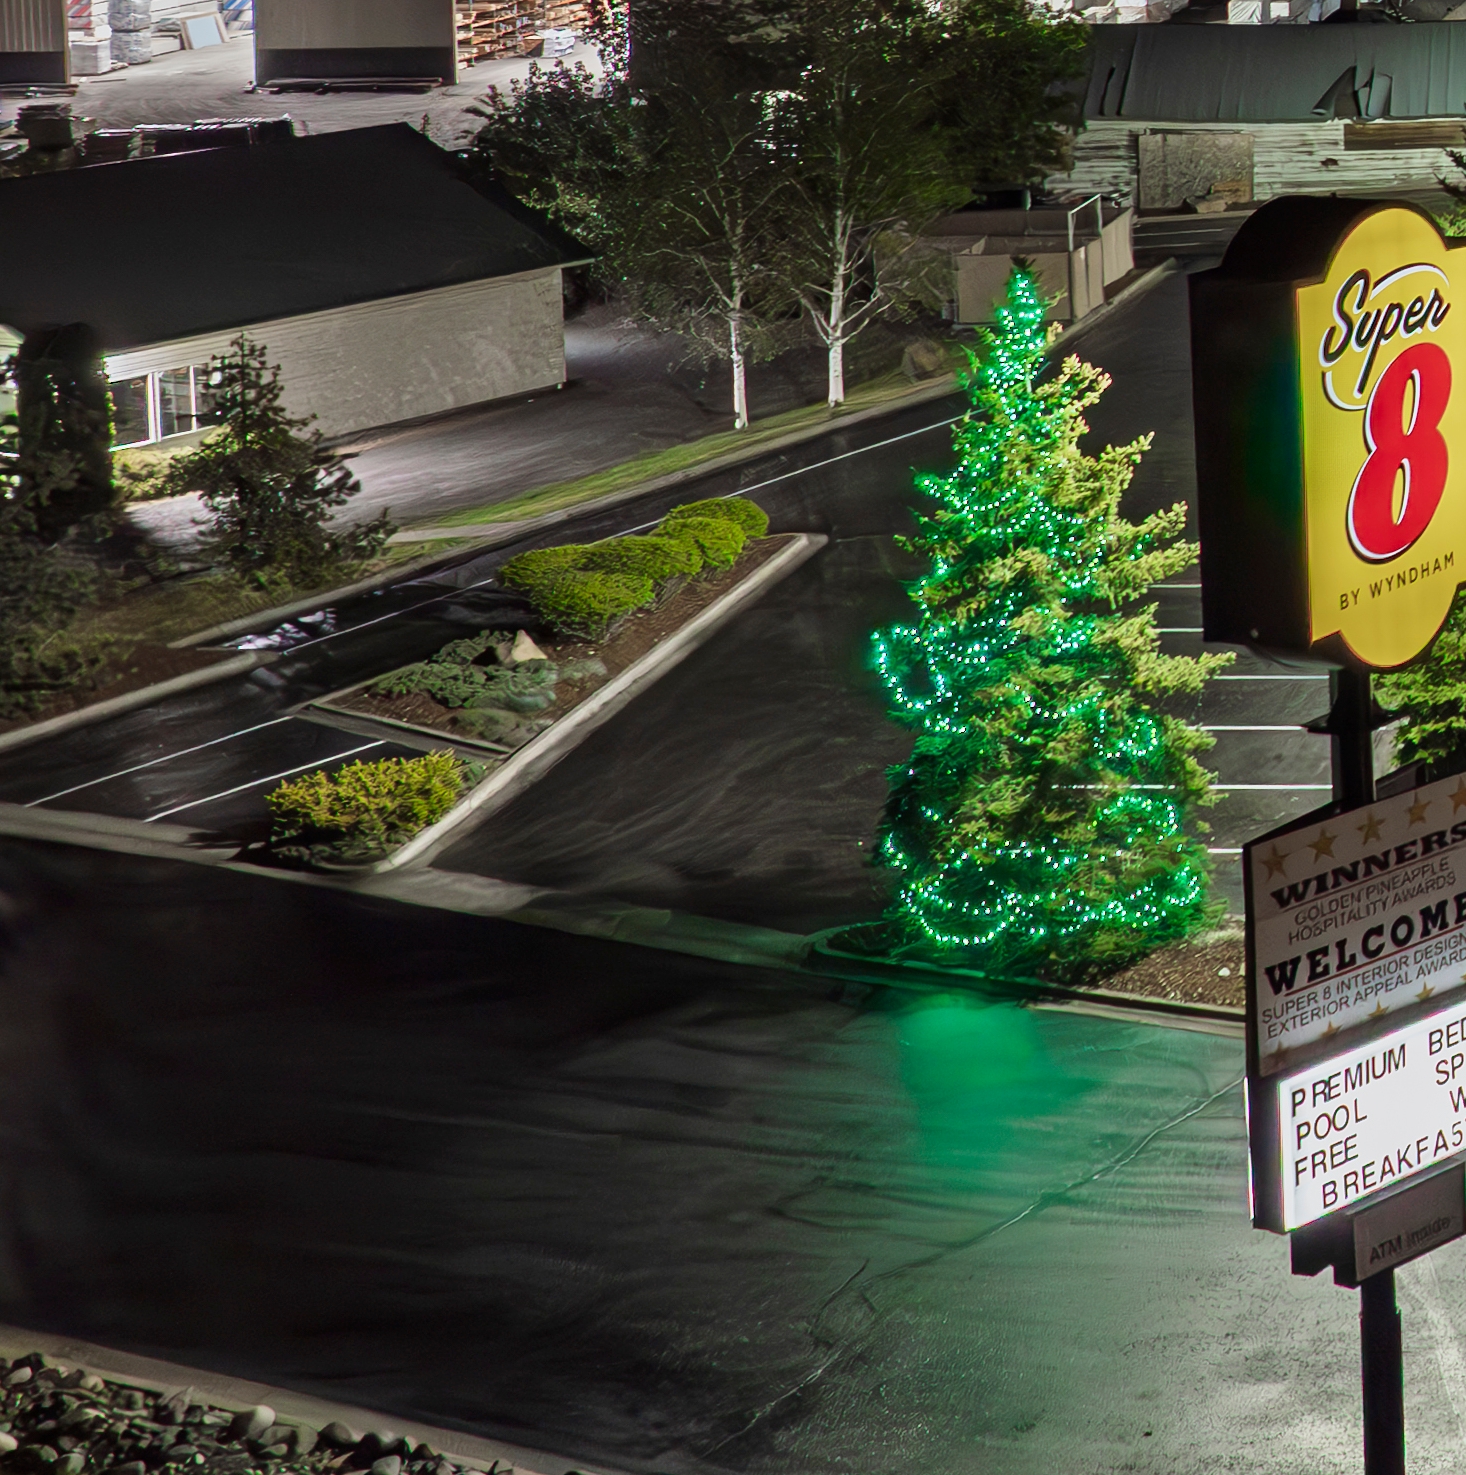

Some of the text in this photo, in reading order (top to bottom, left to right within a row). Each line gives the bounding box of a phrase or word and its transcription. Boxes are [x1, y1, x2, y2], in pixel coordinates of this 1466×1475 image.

[1319, 268, 1451, 399] Super
[1346, 342, 1453, 566] 8
[1339, 552, 1456, 611] BY WYNDHAM
[1288, 872, 1457, 946] HOSPITALITY AWARDS
[1293, 855, 1450, 926] GOLDEN PINEAPPLE
[1261, 992, 1319, 1025] SUPER
[1323, 986, 1332, 1001] 8
[1336, 954, 1410, 995] INTERIOR
[1267, 994, 1350, 1040] EXTERIOR
[1353, 971, 1413, 1006] APPEAL
[1291, 1043, 1407, 1118] PREMIUM
[1296, 1097, 1368, 1151] POOL
[1294, 1133, 1359, 1188] FREE
[1369, 1233, 1402, 1265] ATM
